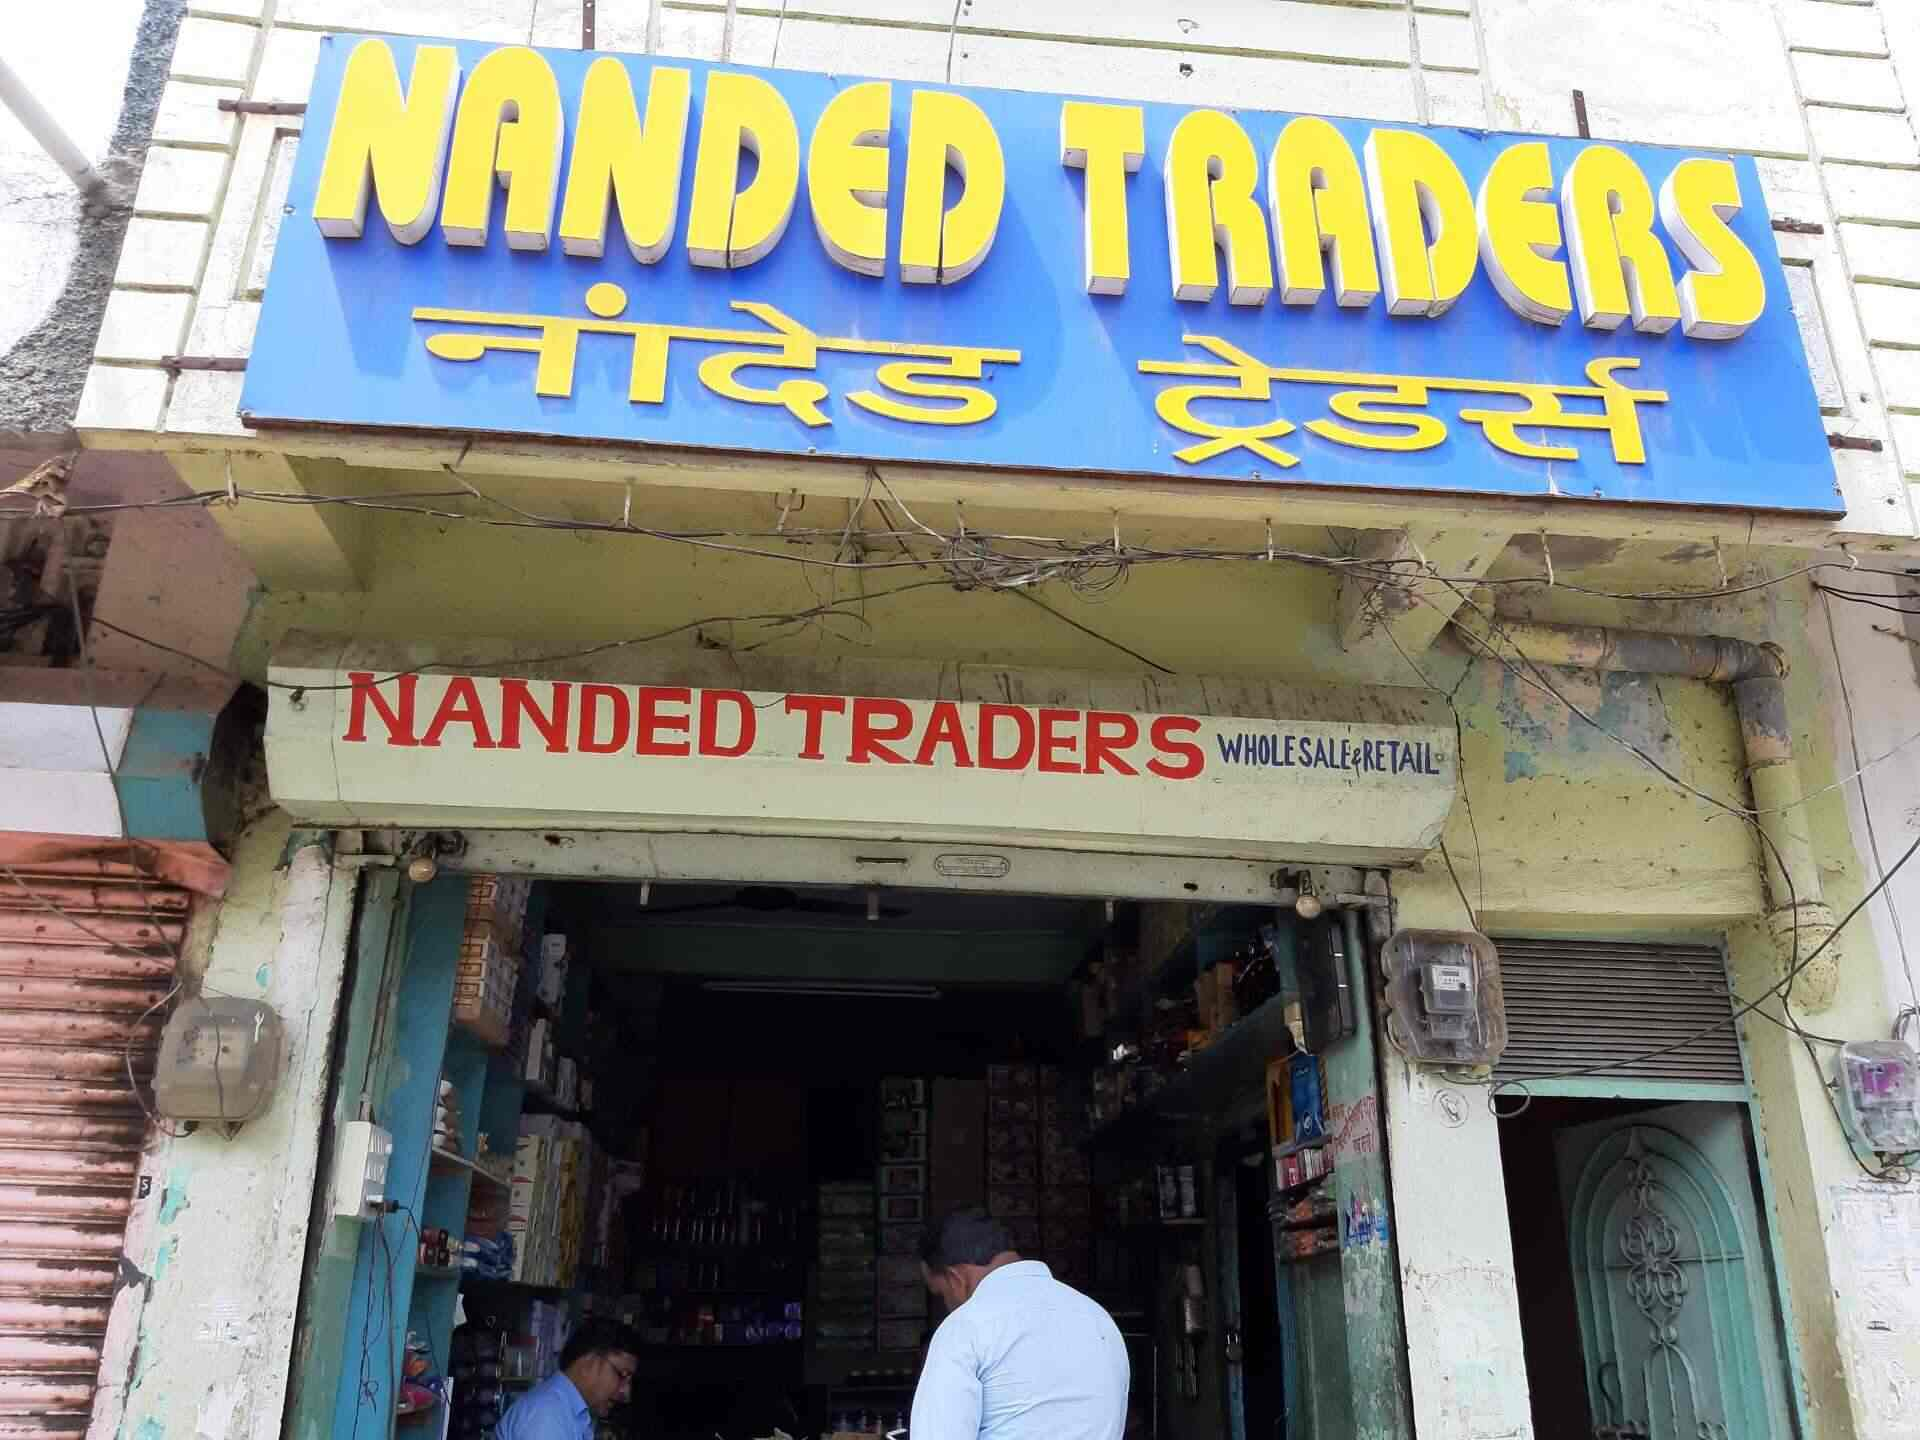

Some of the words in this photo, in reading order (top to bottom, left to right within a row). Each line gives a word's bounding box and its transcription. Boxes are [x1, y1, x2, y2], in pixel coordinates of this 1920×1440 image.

[314, 39, 1005, 284] NANDED
[1060, 101, 1766, 340] TRADERS
[412, 282, 1021, 427] नांदेड
[1138, 335, 1669, 468] ट्रेडर्स
[342, 671, 757, 758] NANDED
[784, 694, 1206, 780] TRADERS
